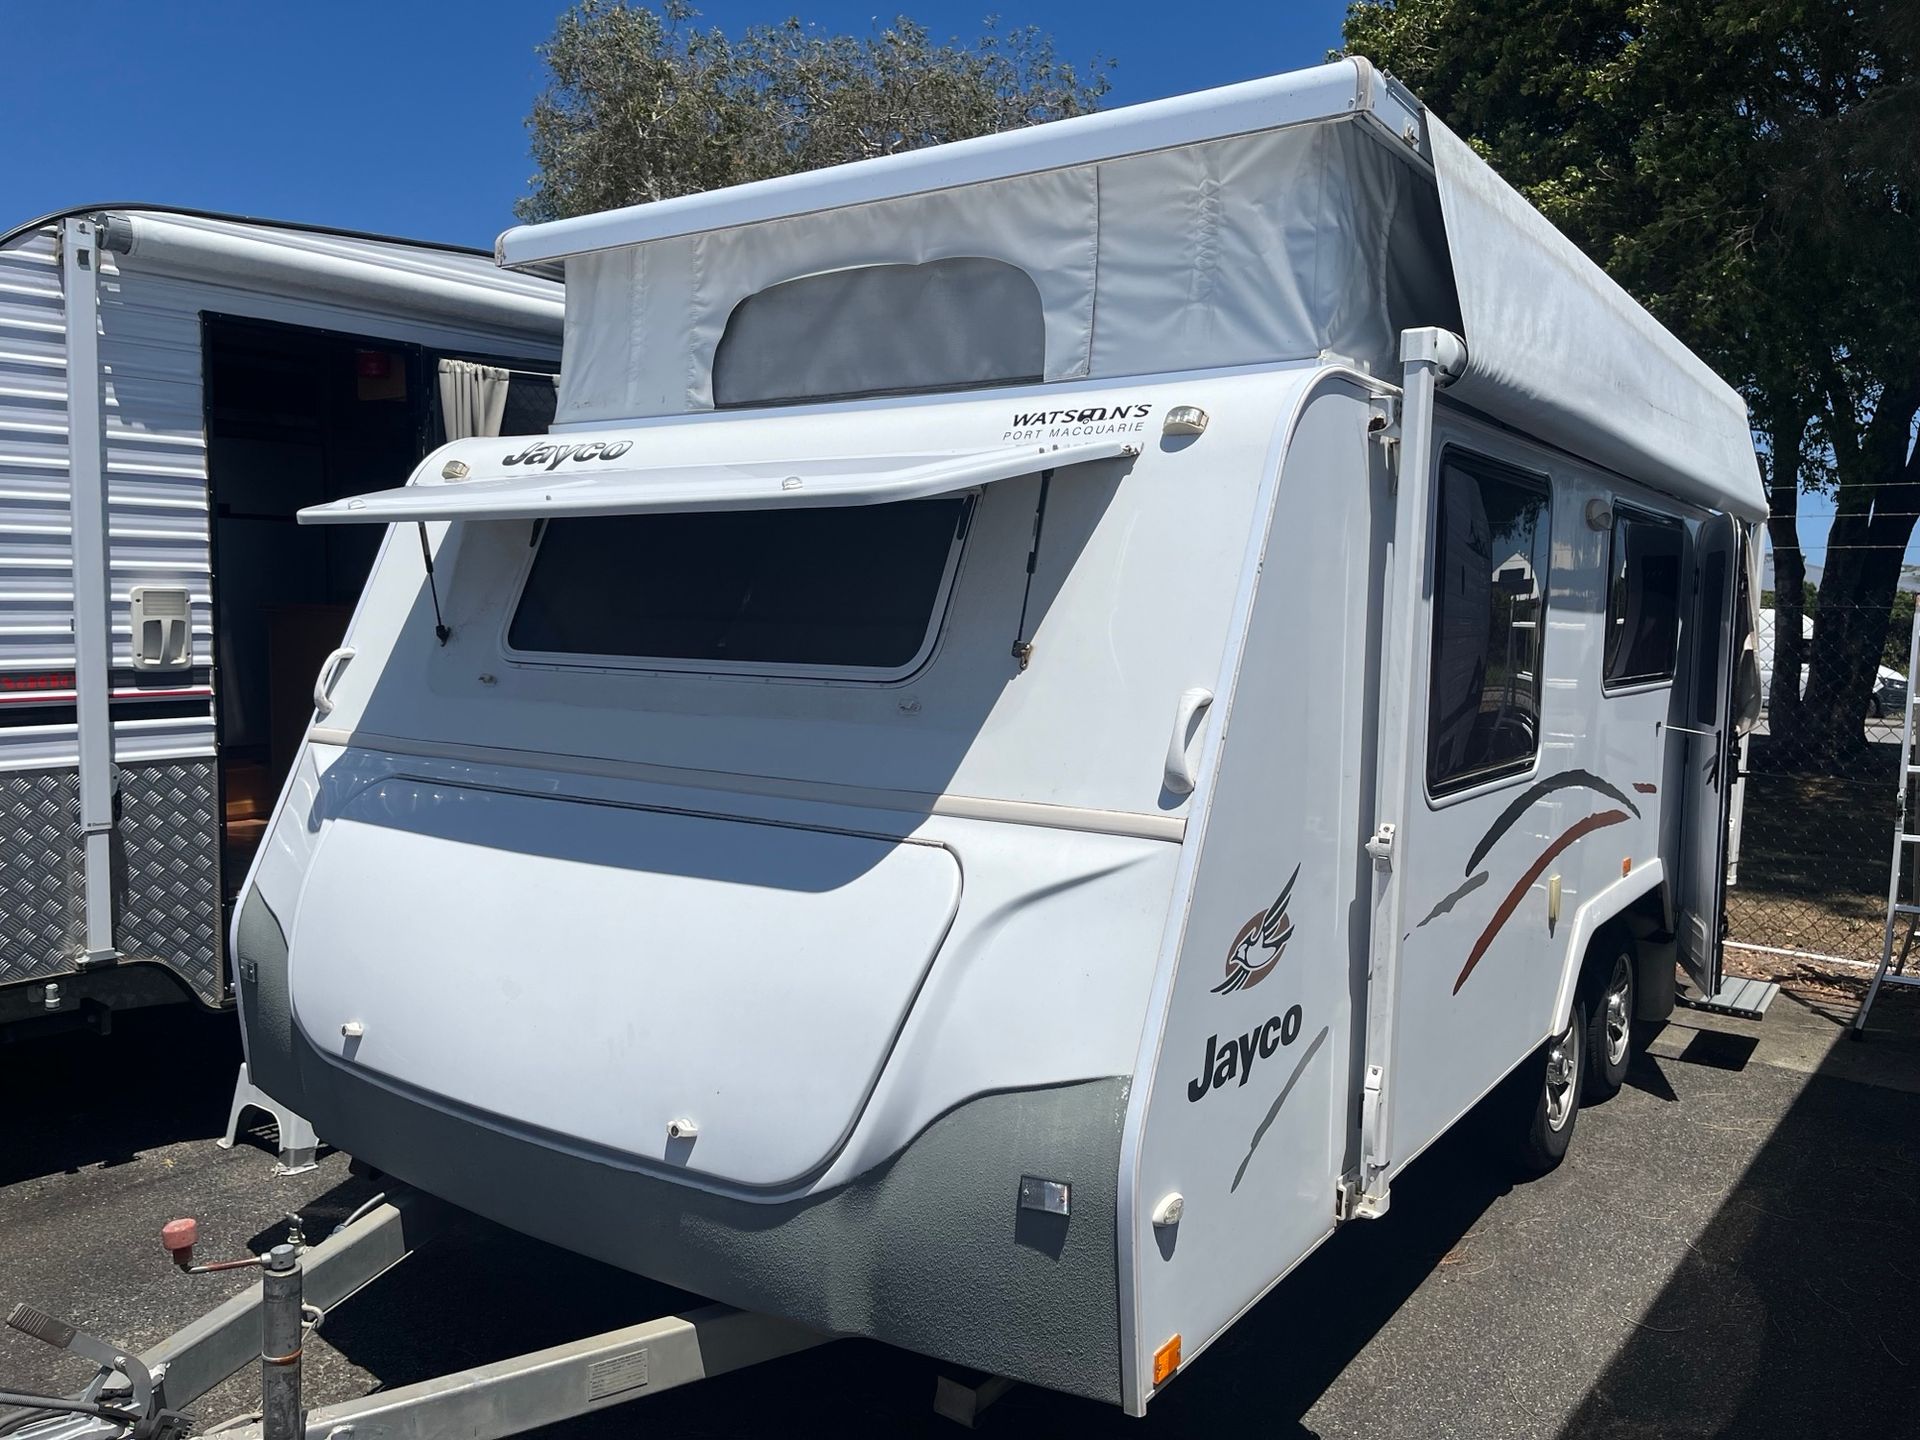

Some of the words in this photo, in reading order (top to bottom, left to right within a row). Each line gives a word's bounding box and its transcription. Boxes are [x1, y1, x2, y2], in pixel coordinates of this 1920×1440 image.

[1003, 429, 1043, 441] PORT
[1049, 421, 1145, 438] MACQUARIE
[501, 440, 634, 471] Jayco
[1187, 1003, 1303, 1103] Jayco
